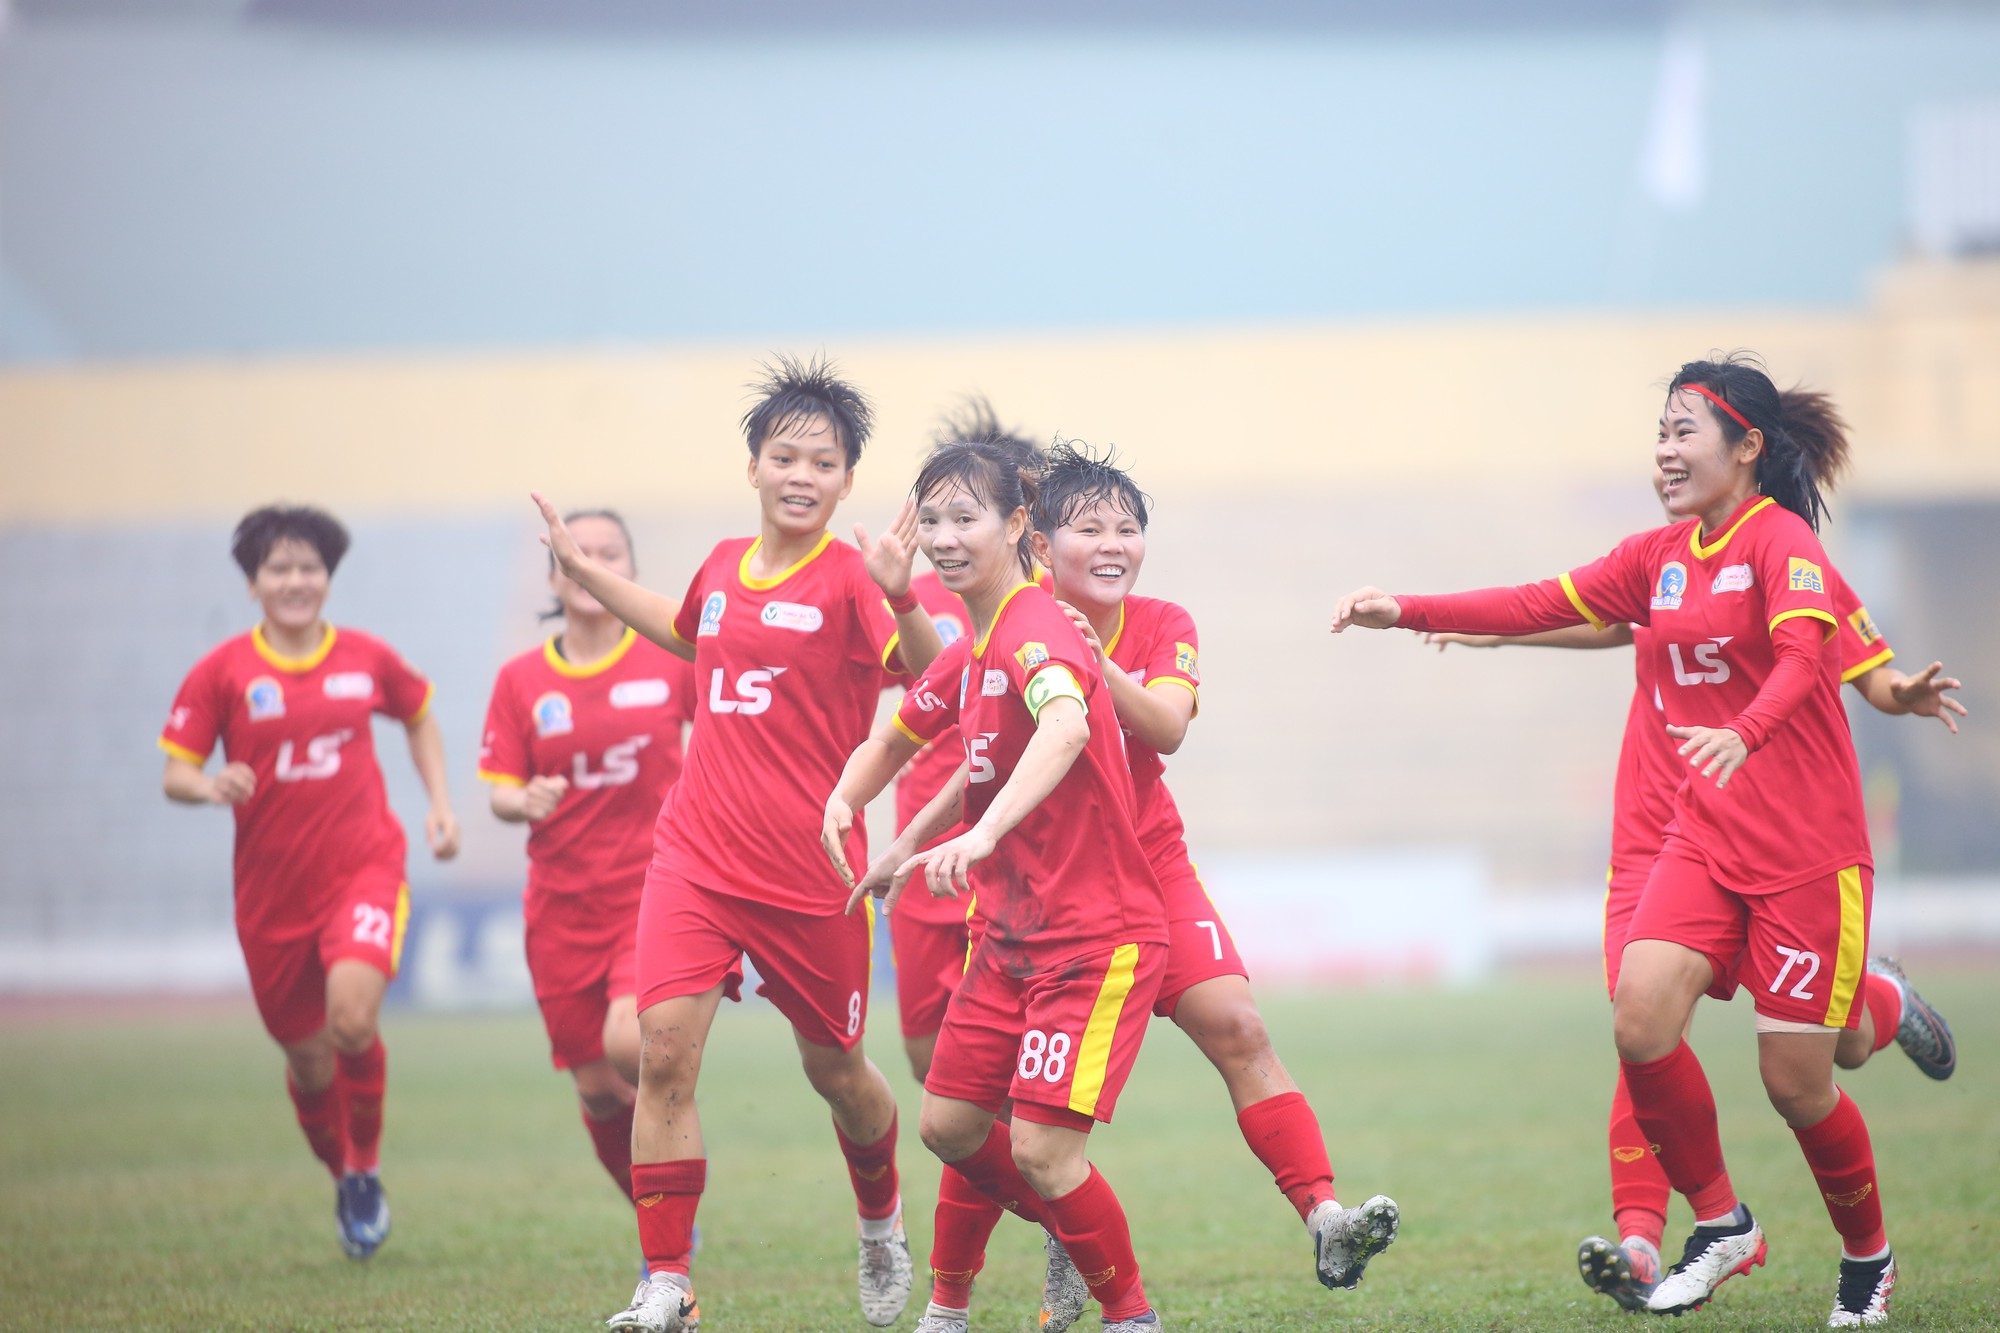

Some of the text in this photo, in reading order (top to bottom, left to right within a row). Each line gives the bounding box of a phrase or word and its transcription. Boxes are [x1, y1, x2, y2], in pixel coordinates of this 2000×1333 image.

[1791, 577, 1822, 592] TSB
[1667, 640, 1732, 686] LS
[708, 667, 776, 715] LS
[1028, 676, 1050, 710] C
[275, 732, 347, 782] LS
[572, 737, 645, 789] LS
[963, 735, 997, 785] S
[353, 902, 392, 950] 22
[1194, 920, 1224, 961] 7
[1768, 944, 1821, 1000] 72
[847, 990, 862, 1037] 8
[1017, 1029, 1071, 1083] 88
